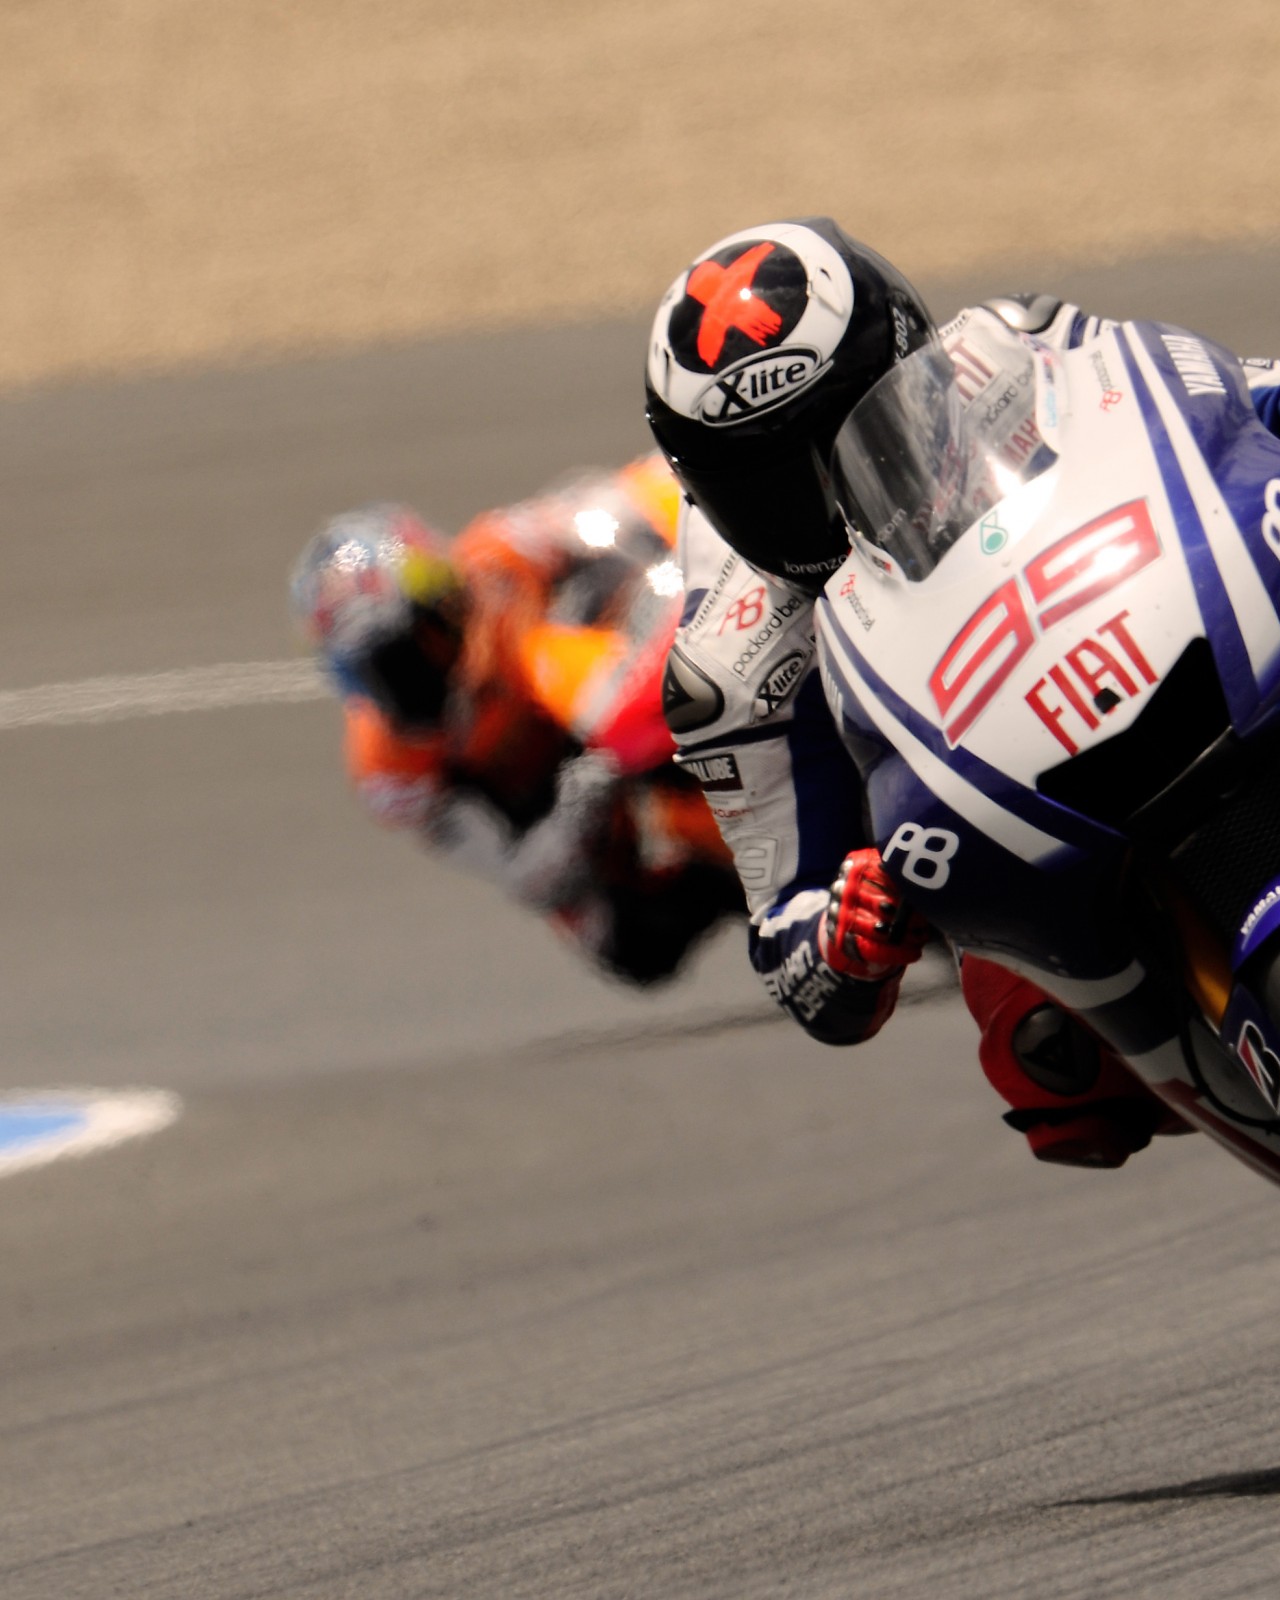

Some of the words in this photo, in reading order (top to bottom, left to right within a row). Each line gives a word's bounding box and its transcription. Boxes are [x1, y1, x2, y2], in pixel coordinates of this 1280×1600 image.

[714, 361, 807, 419] X-lite
[1160, 333, 1227, 396] YAMAHA
[733, 613, 783, 677] packard
[928, 497, 1162, 747] 99
[1024, 609, 1159, 758] FIAT
